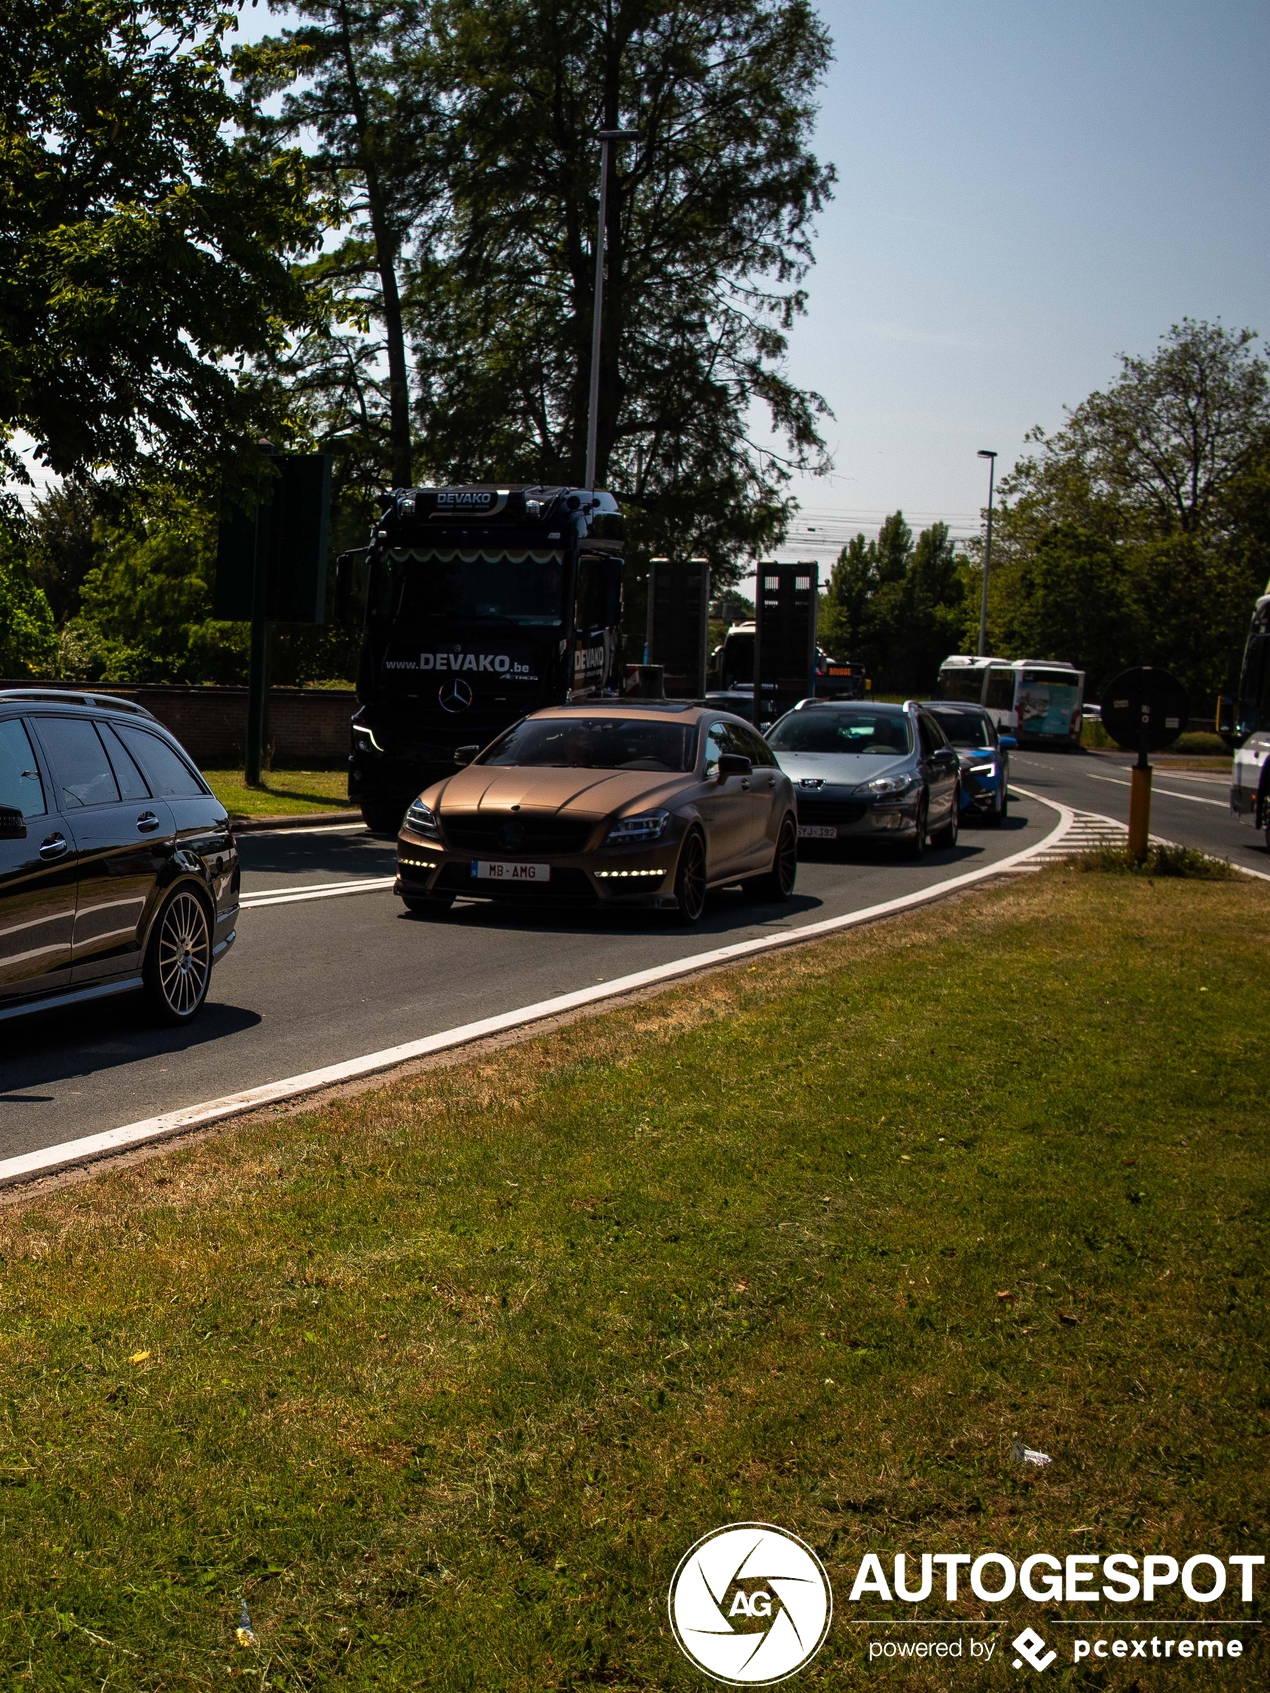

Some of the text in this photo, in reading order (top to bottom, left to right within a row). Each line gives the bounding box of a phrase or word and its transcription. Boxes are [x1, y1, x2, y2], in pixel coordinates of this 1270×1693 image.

[437, 493, 491, 503] DEVAKO
[386, 653, 529, 673] www.DEVAKO.be
[574, 646, 604, 671] DEVAKO
[829, 667, 851, 677] BRUGGE
